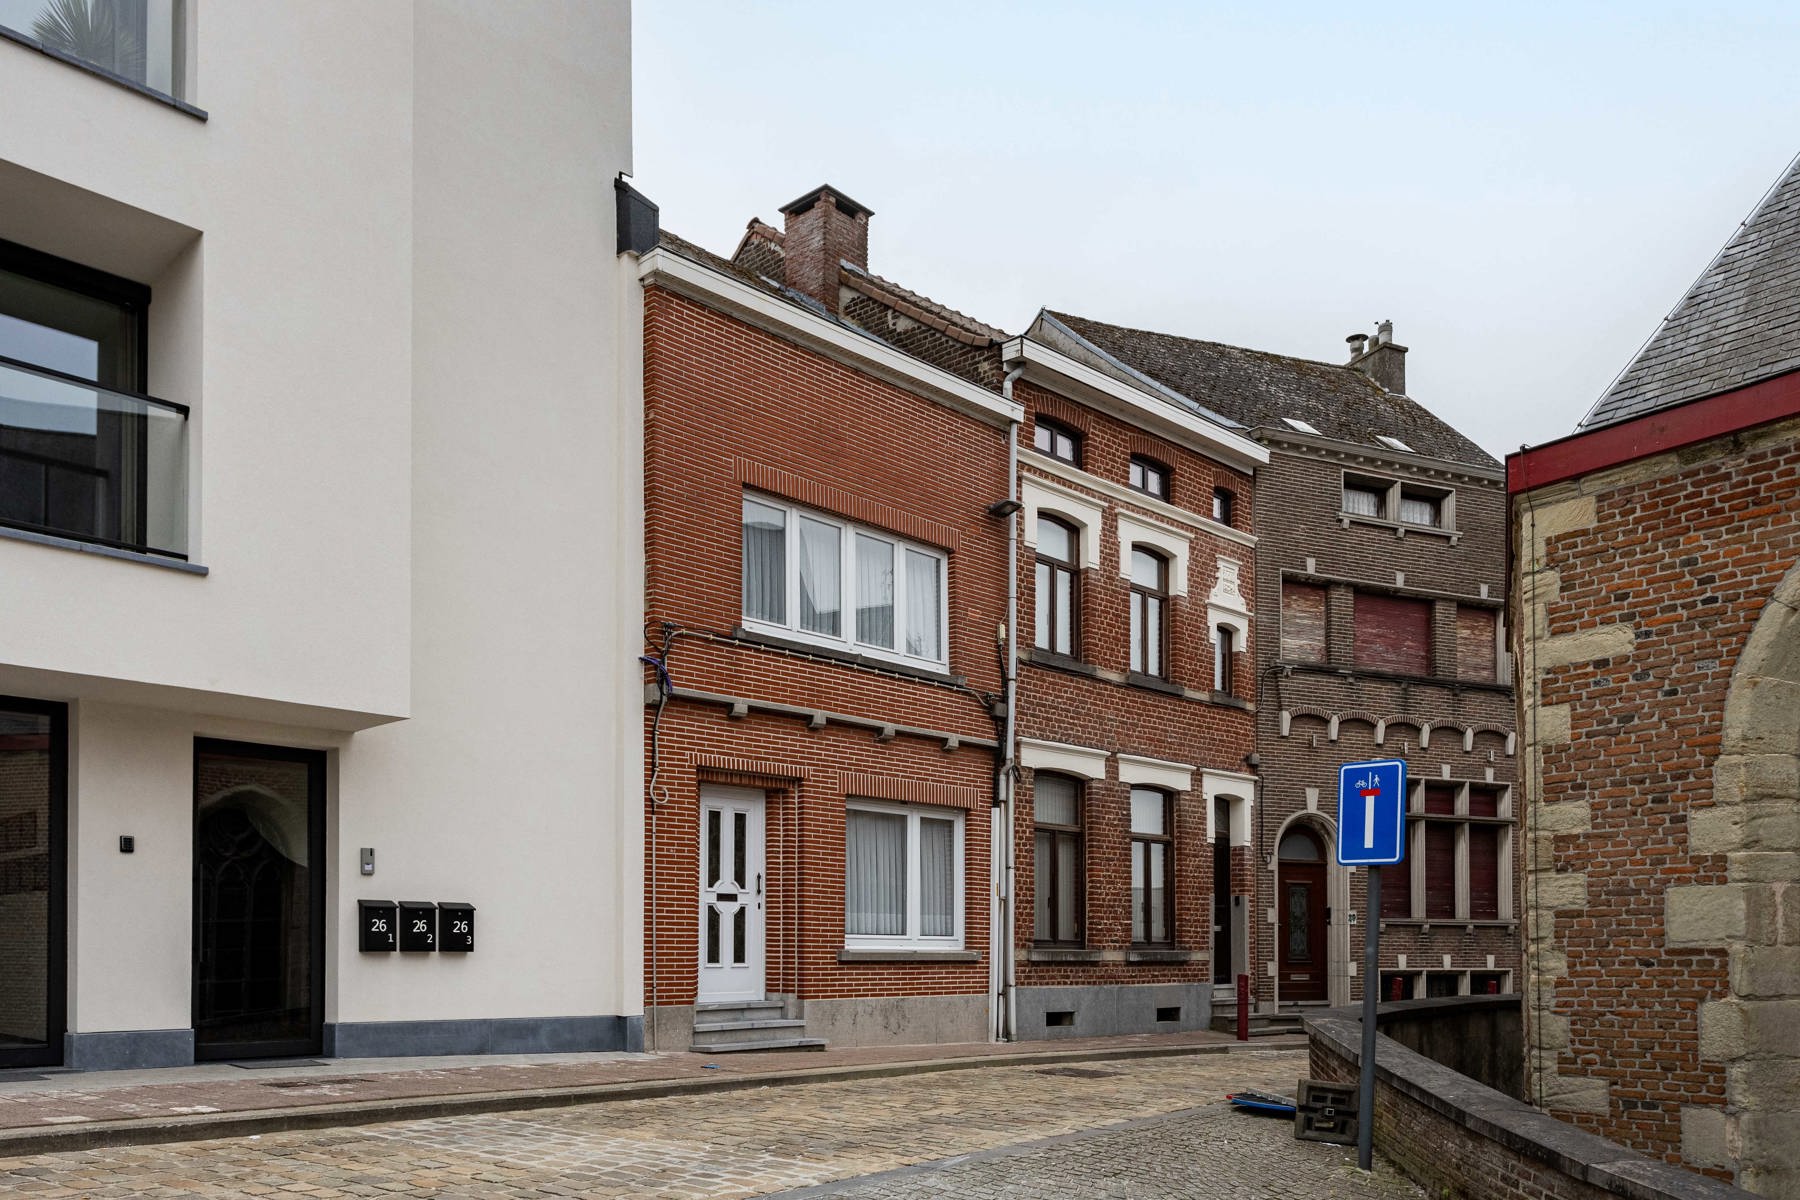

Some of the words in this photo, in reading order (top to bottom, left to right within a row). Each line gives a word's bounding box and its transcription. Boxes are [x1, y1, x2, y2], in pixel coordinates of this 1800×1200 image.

[371, 919, 387, 932] 26
[412, 920, 427, 932] 26
[453, 921, 468, 933] 26
[388, 934, 394, 942] 1
[427, 934, 433, 943] 2
[466, 936, 472, 944] 3
